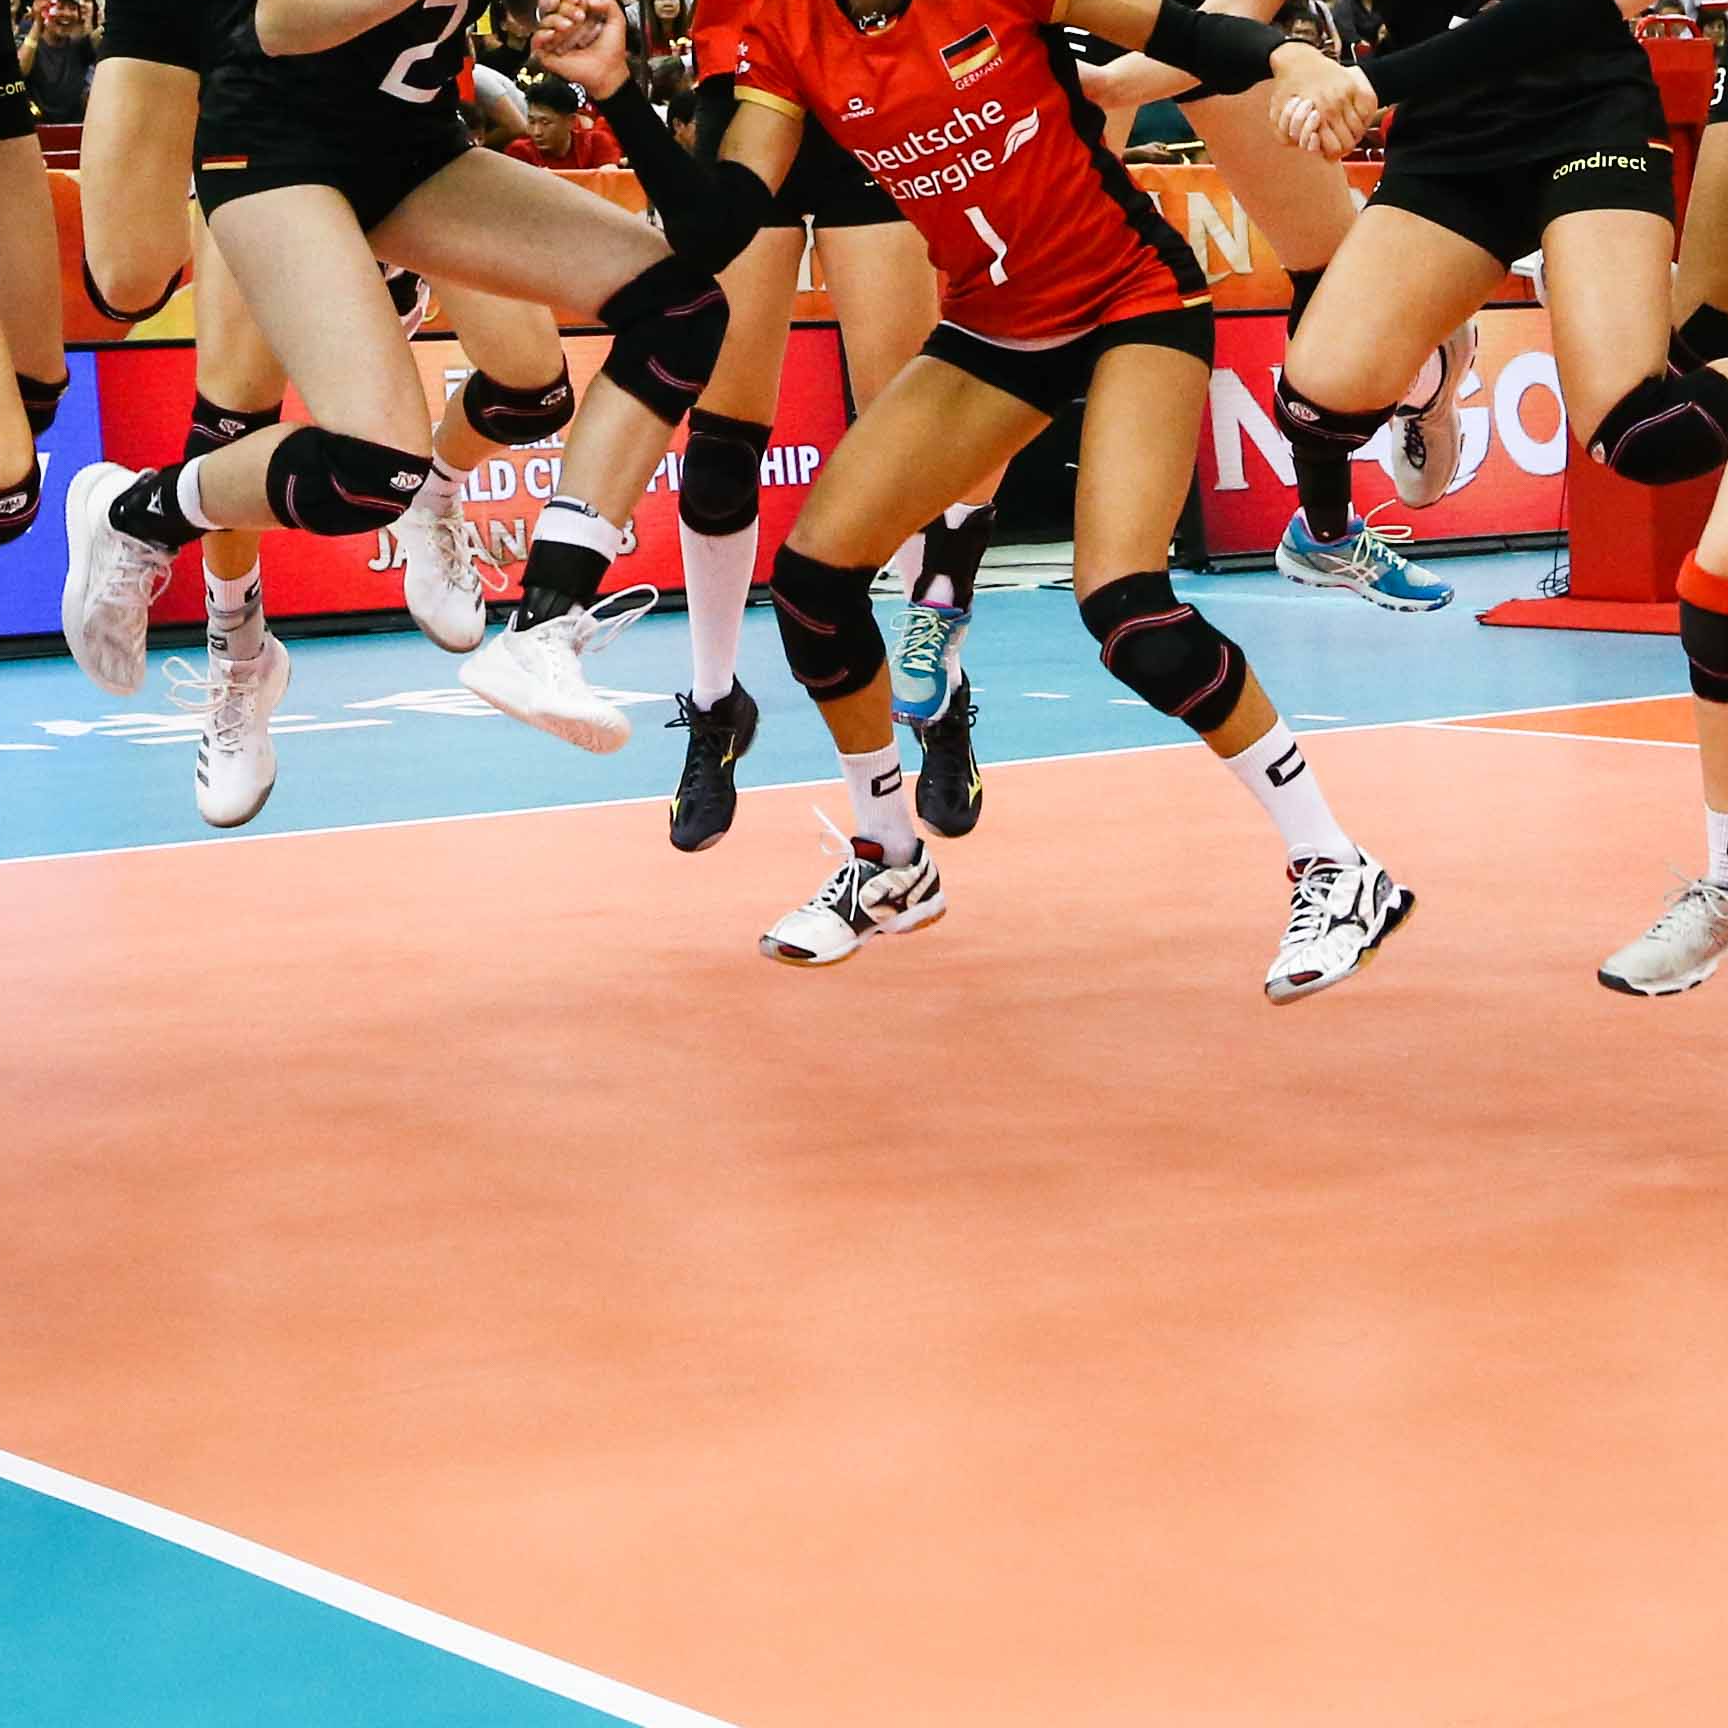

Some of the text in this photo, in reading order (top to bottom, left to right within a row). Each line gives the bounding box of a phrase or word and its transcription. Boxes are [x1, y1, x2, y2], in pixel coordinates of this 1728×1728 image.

[954, 56, 1005, 91] GERMANY
[853, 99, 1006, 172] Deutsche
[883, 152, 995, 201] Energie
[1553, 151, 1647, 180] comdirect
[964, 206, 1009, 287] 1
